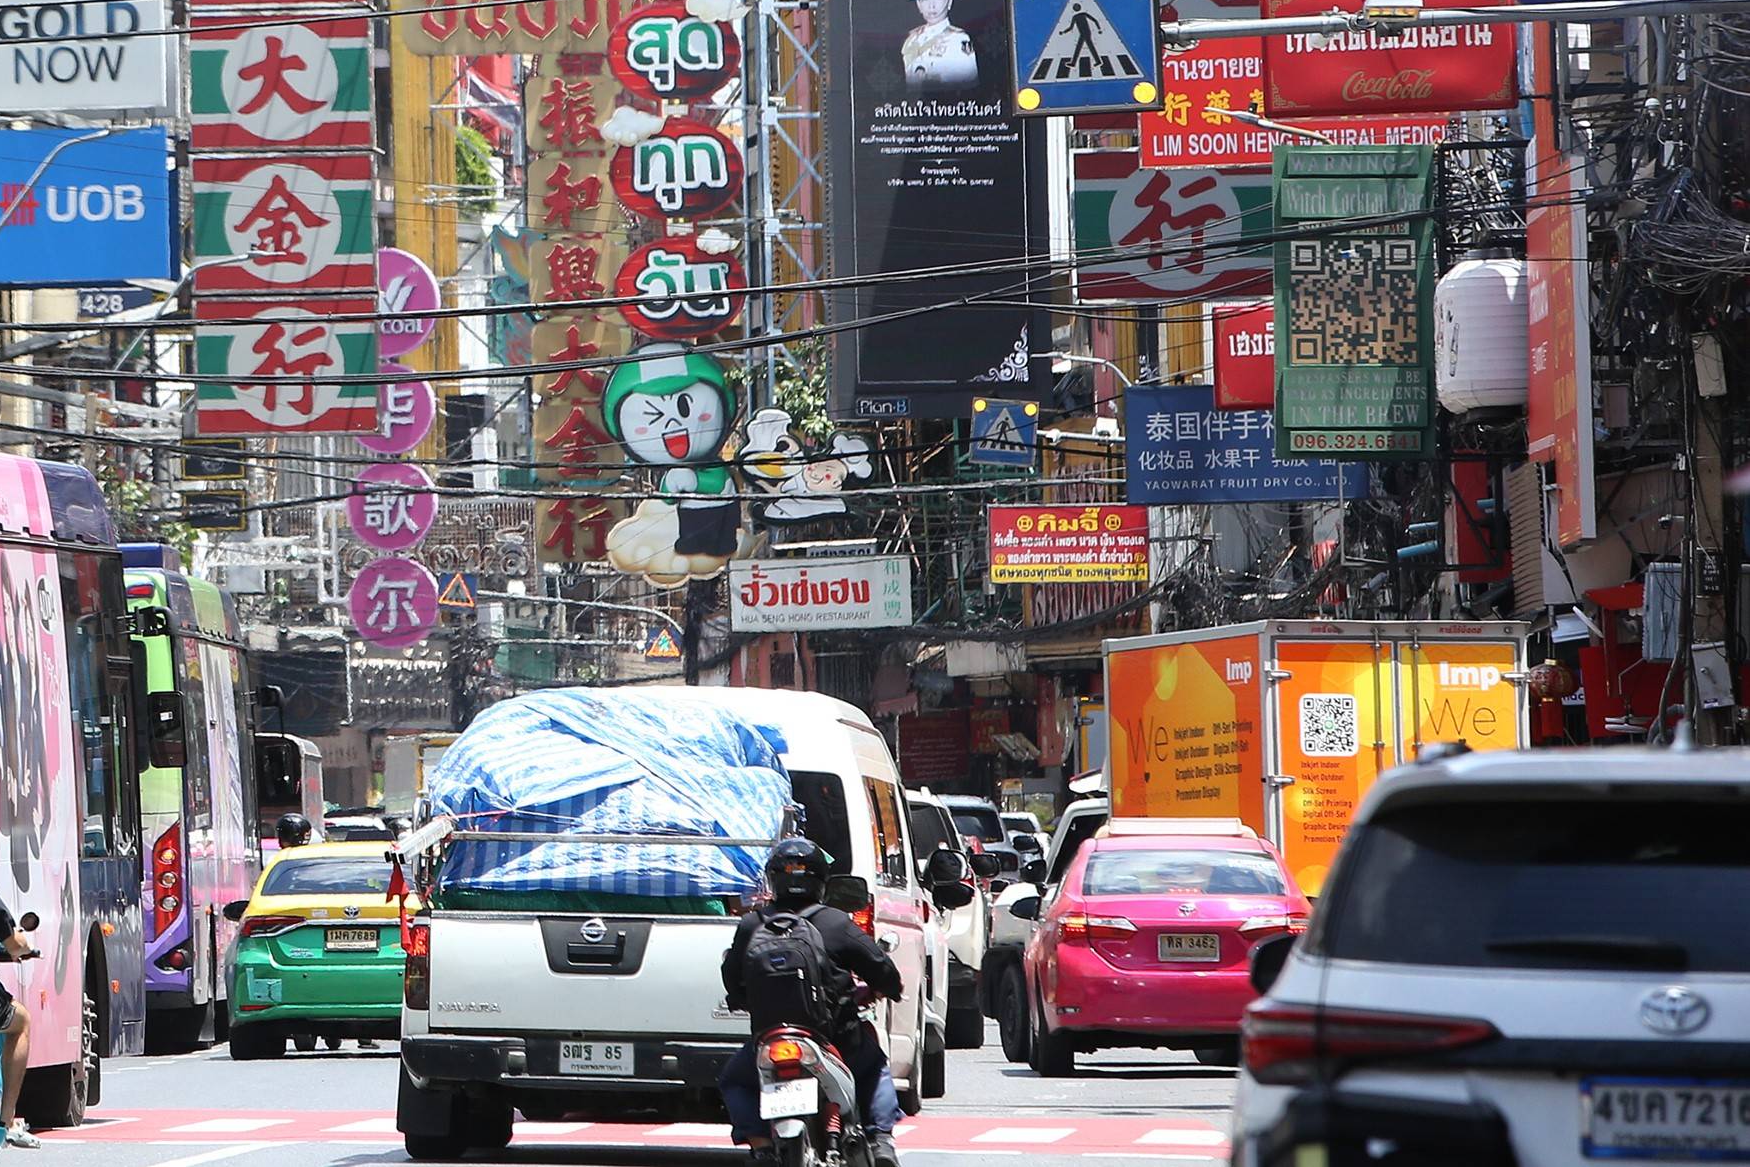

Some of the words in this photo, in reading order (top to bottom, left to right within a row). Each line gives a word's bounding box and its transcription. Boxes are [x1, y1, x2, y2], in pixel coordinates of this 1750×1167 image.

[632, 21, 720, 85] สุด
[13, 45, 125, 85] NOW
[874, 100, 1001, 119] สถิตในใจไทยนิรันดร์
[1153, 135, 1183, 157] LIM
[1188, 133, 1239, 156] SOON
[1245, 132, 1294, 155] HENG
[640, 140, 722, 203] ทุก
[1291, 155, 1396, 172] WARNING
[46, 184, 146, 224] UOB
[641, 255, 728, 316] วัน
[81, 293, 125, 314] 428
[1406, 370, 1420, 383] BE
[1340, 386, 1427, 402] INGREDIENTS
[1291, 406, 1311, 425] IN
[1319, 405, 1357, 425] THE
[1366, 404, 1420, 425] BREW
[1138, 450, 1194, 472] 化妆品
[1204, 448, 1261, 471] 水果干
[1144, 479, 1215, 491] YAOWARAT
[1219, 478, 1258, 489] FRUIT
[1263, 477, 1289, 488] DRY
[1294, 476, 1322, 488] CO.,
[741, 614, 759, 624] HUA
[761, 613, 786, 624] SENG
[788, 612, 813, 623] HONG
[815, 610, 872, 622] RESTAURANT
[1423, 697, 1497, 737] We
[1127, 715, 1169, 765] We
[604, 1045, 622, 1060] 85
